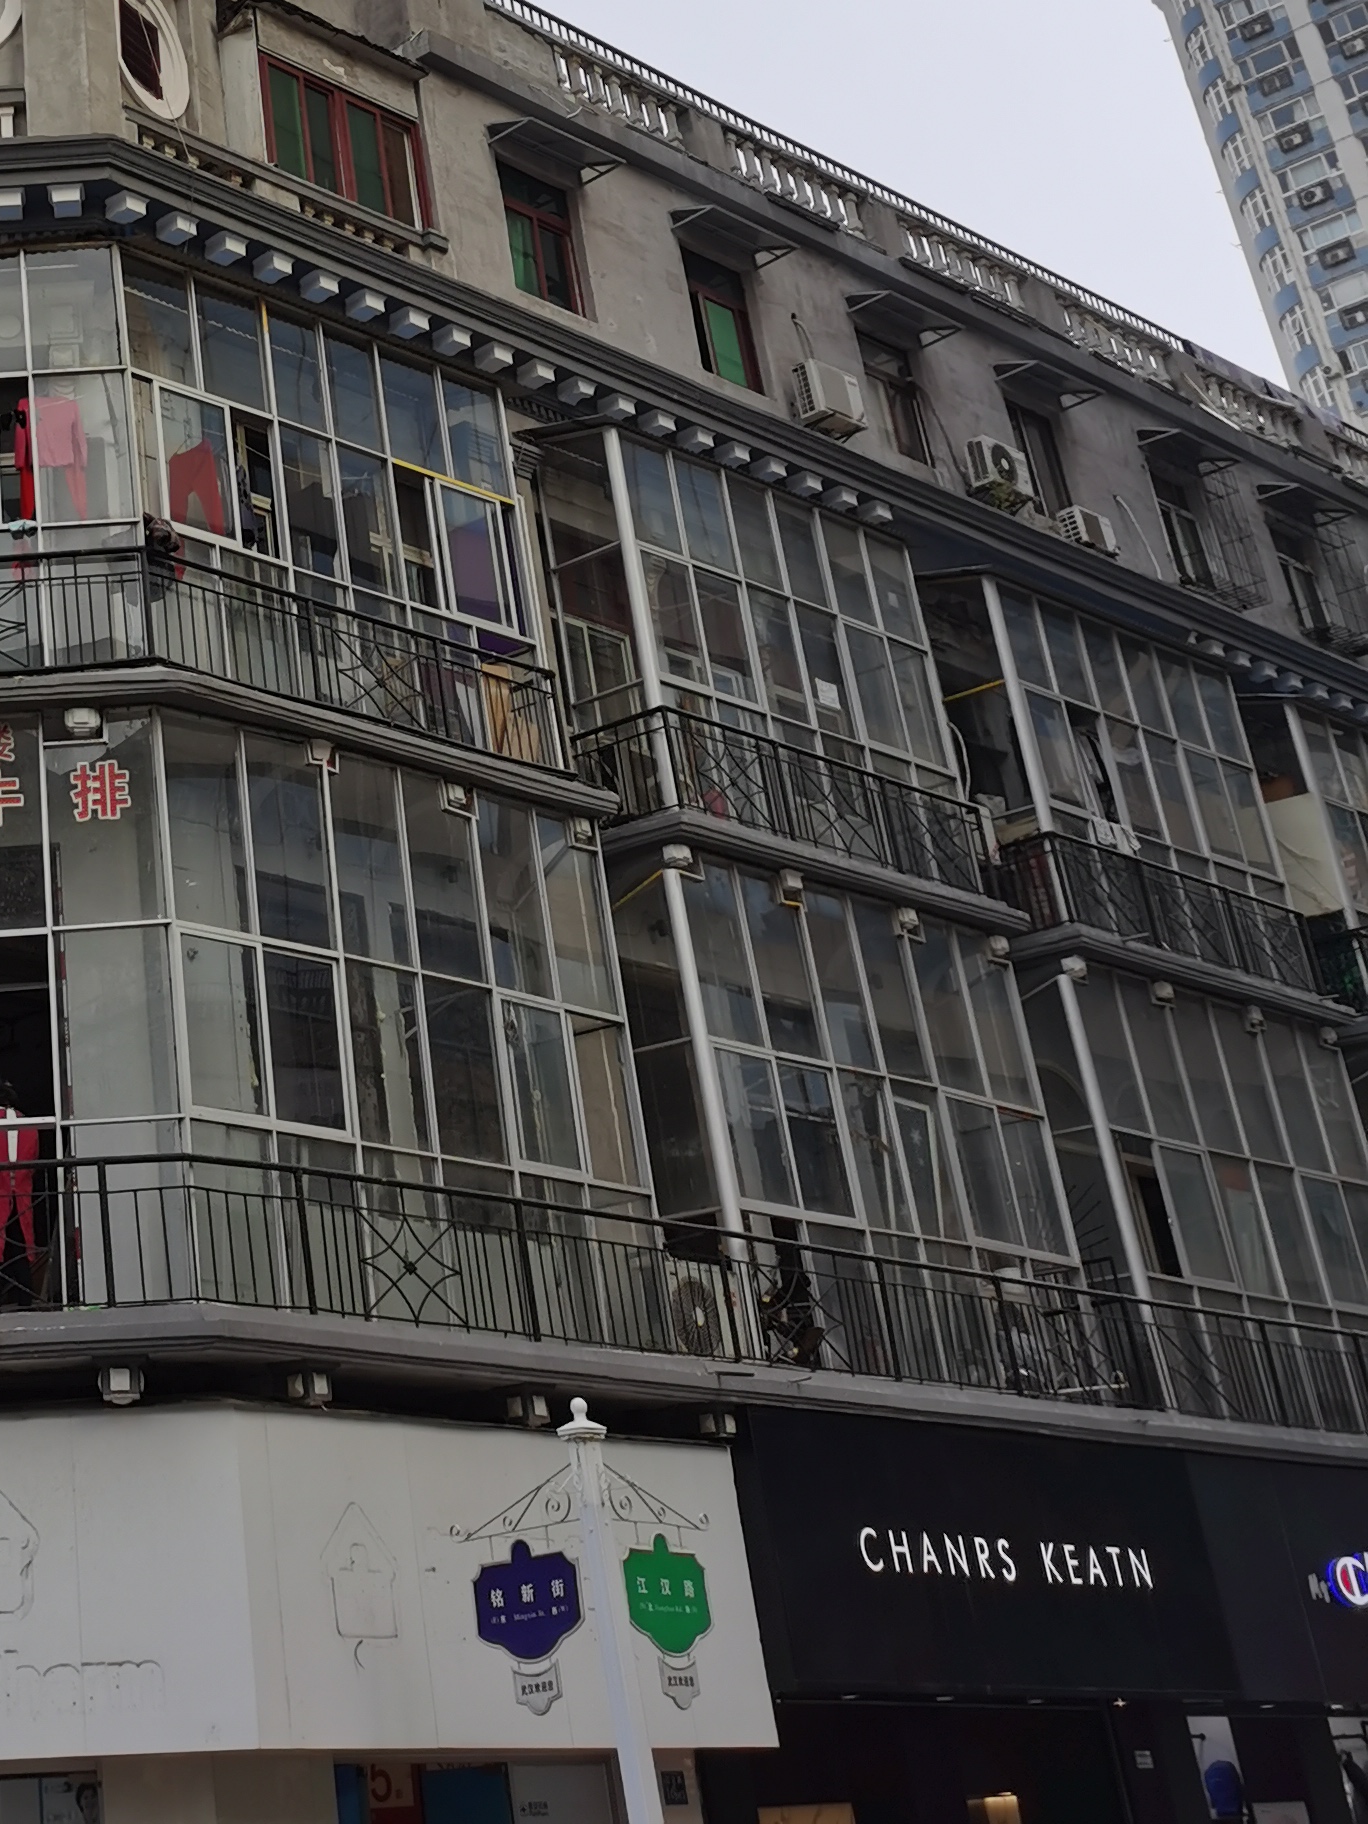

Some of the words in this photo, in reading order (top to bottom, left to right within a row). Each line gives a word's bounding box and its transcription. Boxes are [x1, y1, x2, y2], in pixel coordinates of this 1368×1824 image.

[859, 1526, 1018, 1583] CHANRS
[1039, 1541, 1155, 1591] KEATN
[489, 1578, 566, 1609] 铭新街
[635, 1575, 696, 1599] 江汉路
